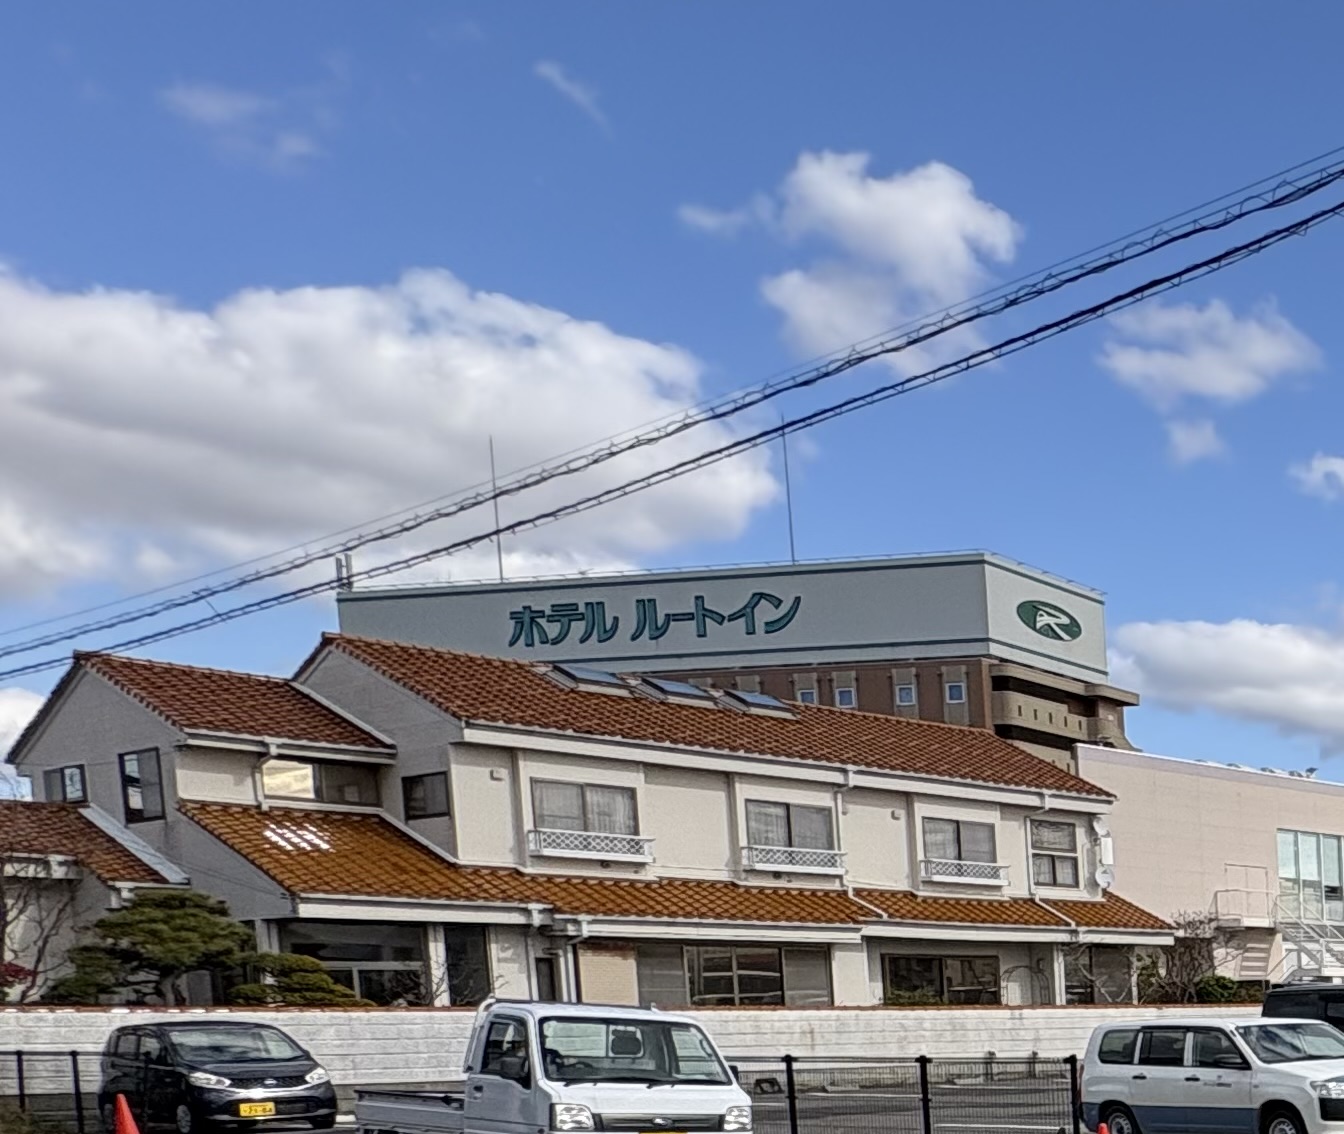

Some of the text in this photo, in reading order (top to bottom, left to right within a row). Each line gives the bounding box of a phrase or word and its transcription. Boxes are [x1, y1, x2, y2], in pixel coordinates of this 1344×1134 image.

[509, 592, 801, 647] ホテル ルートイン
